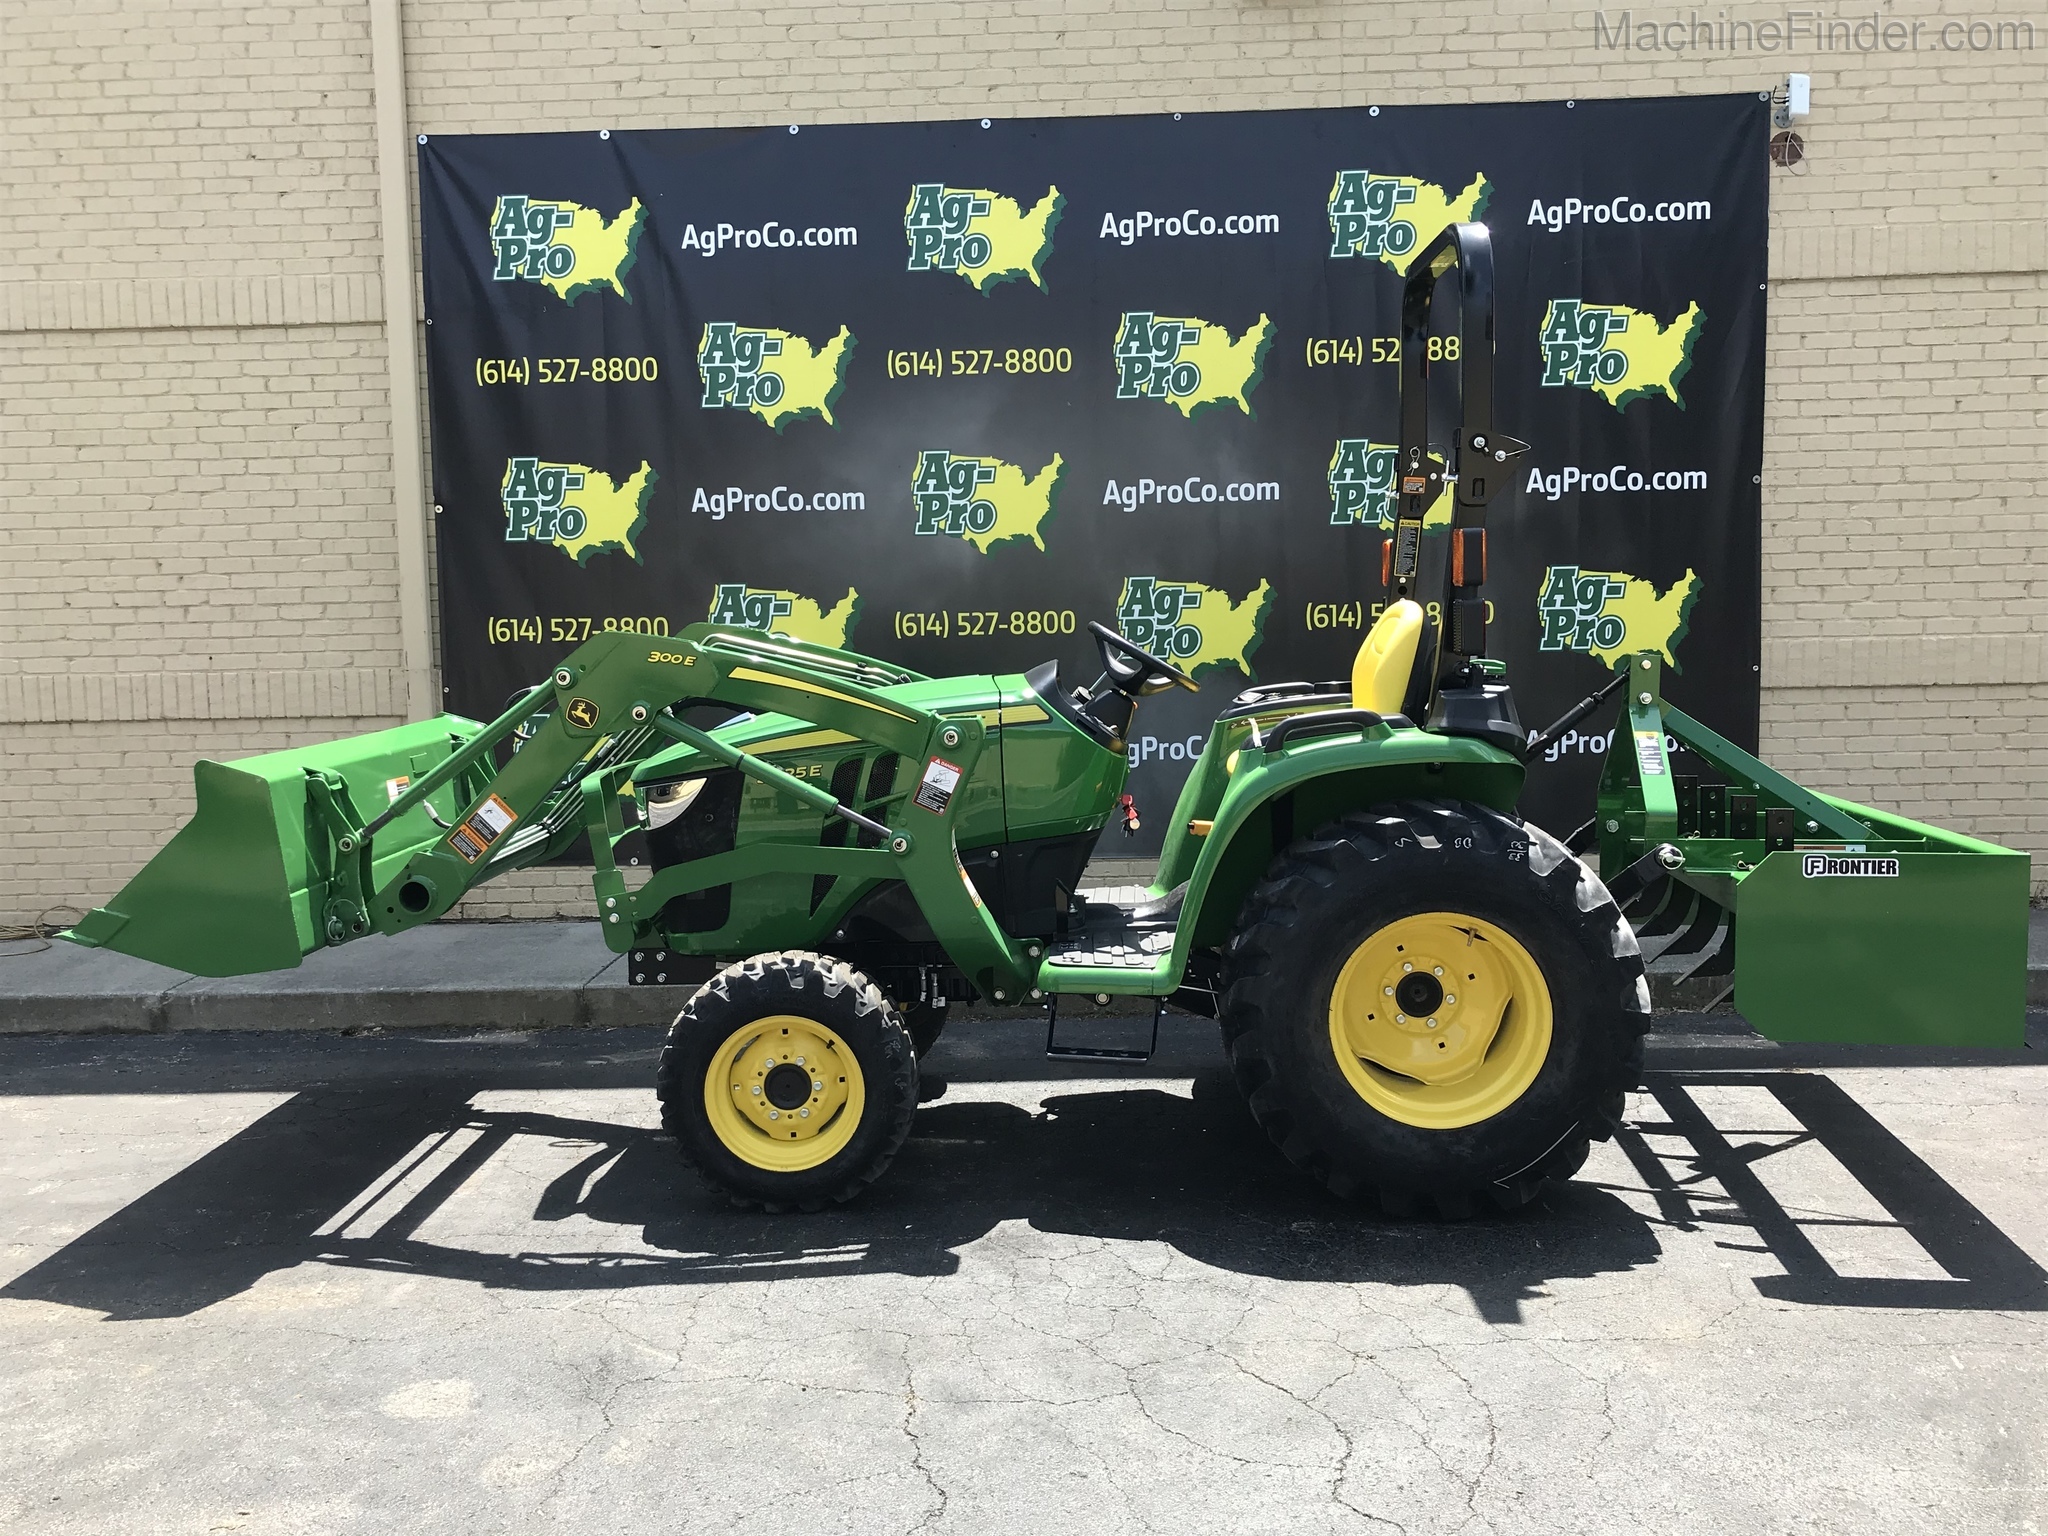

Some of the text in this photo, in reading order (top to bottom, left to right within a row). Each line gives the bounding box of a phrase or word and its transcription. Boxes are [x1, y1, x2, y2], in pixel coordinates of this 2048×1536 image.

[908, 183, 991, 236] Ag-
[1331, 169, 1416, 222] Ag-
[1527, 196, 1711, 233] AgProCo.com
[494, 195, 575, 246] Ag-
[681, 221, 858, 257] AgProCo.com
[1099, 209, 1279, 246] AgProCo.com
[1329, 214, 1417, 259] Pro
[493, 237, 576, 281] Pro
[907, 227, 992, 271] Pro
[1116, 311, 1200, 364] Ag-
[1543, 298, 1630, 352] Ag-
[702, 321, 783, 374] Ag-
[887, 347, 1072, 379] (614) 527-8800
[1306, 336, 1363, 368] (614)
[1541, 344, 1630, 387] Pro
[476, 356, 658, 387] (614) 527-8800
[701, 365, 785, 409] Pro
[1116, 356, 1202, 399] Pro
[505, 457, 585, 509] Ag-
[914, 450, 996, 503] Ag-
[1330, 439, 1398, 492] Ag
[1525, 465, 1707, 501] AgProCo.com
[691, 486, 865, 521] AgProCo.com
[914, 493, 997, 536] Pro
[1102, 476, 1280, 513] AgProCo.com
[505, 499, 587, 542] Pro
[711, 584, 791, 632] Ag-
[1118, 576, 1201, 628] Ag-
[1540, 566, 1626, 618] Ag-
[488, 615, 669, 645] (614) 527-8800
[895, 610, 1076, 639] (614) 527-8800
[1306, 601, 1362, 631] (614)
[1539, 609, 1626, 651] Pro
[1121, 618, 1201, 659] Pro
[1804, 855, 1898, 877] FRONTIER
